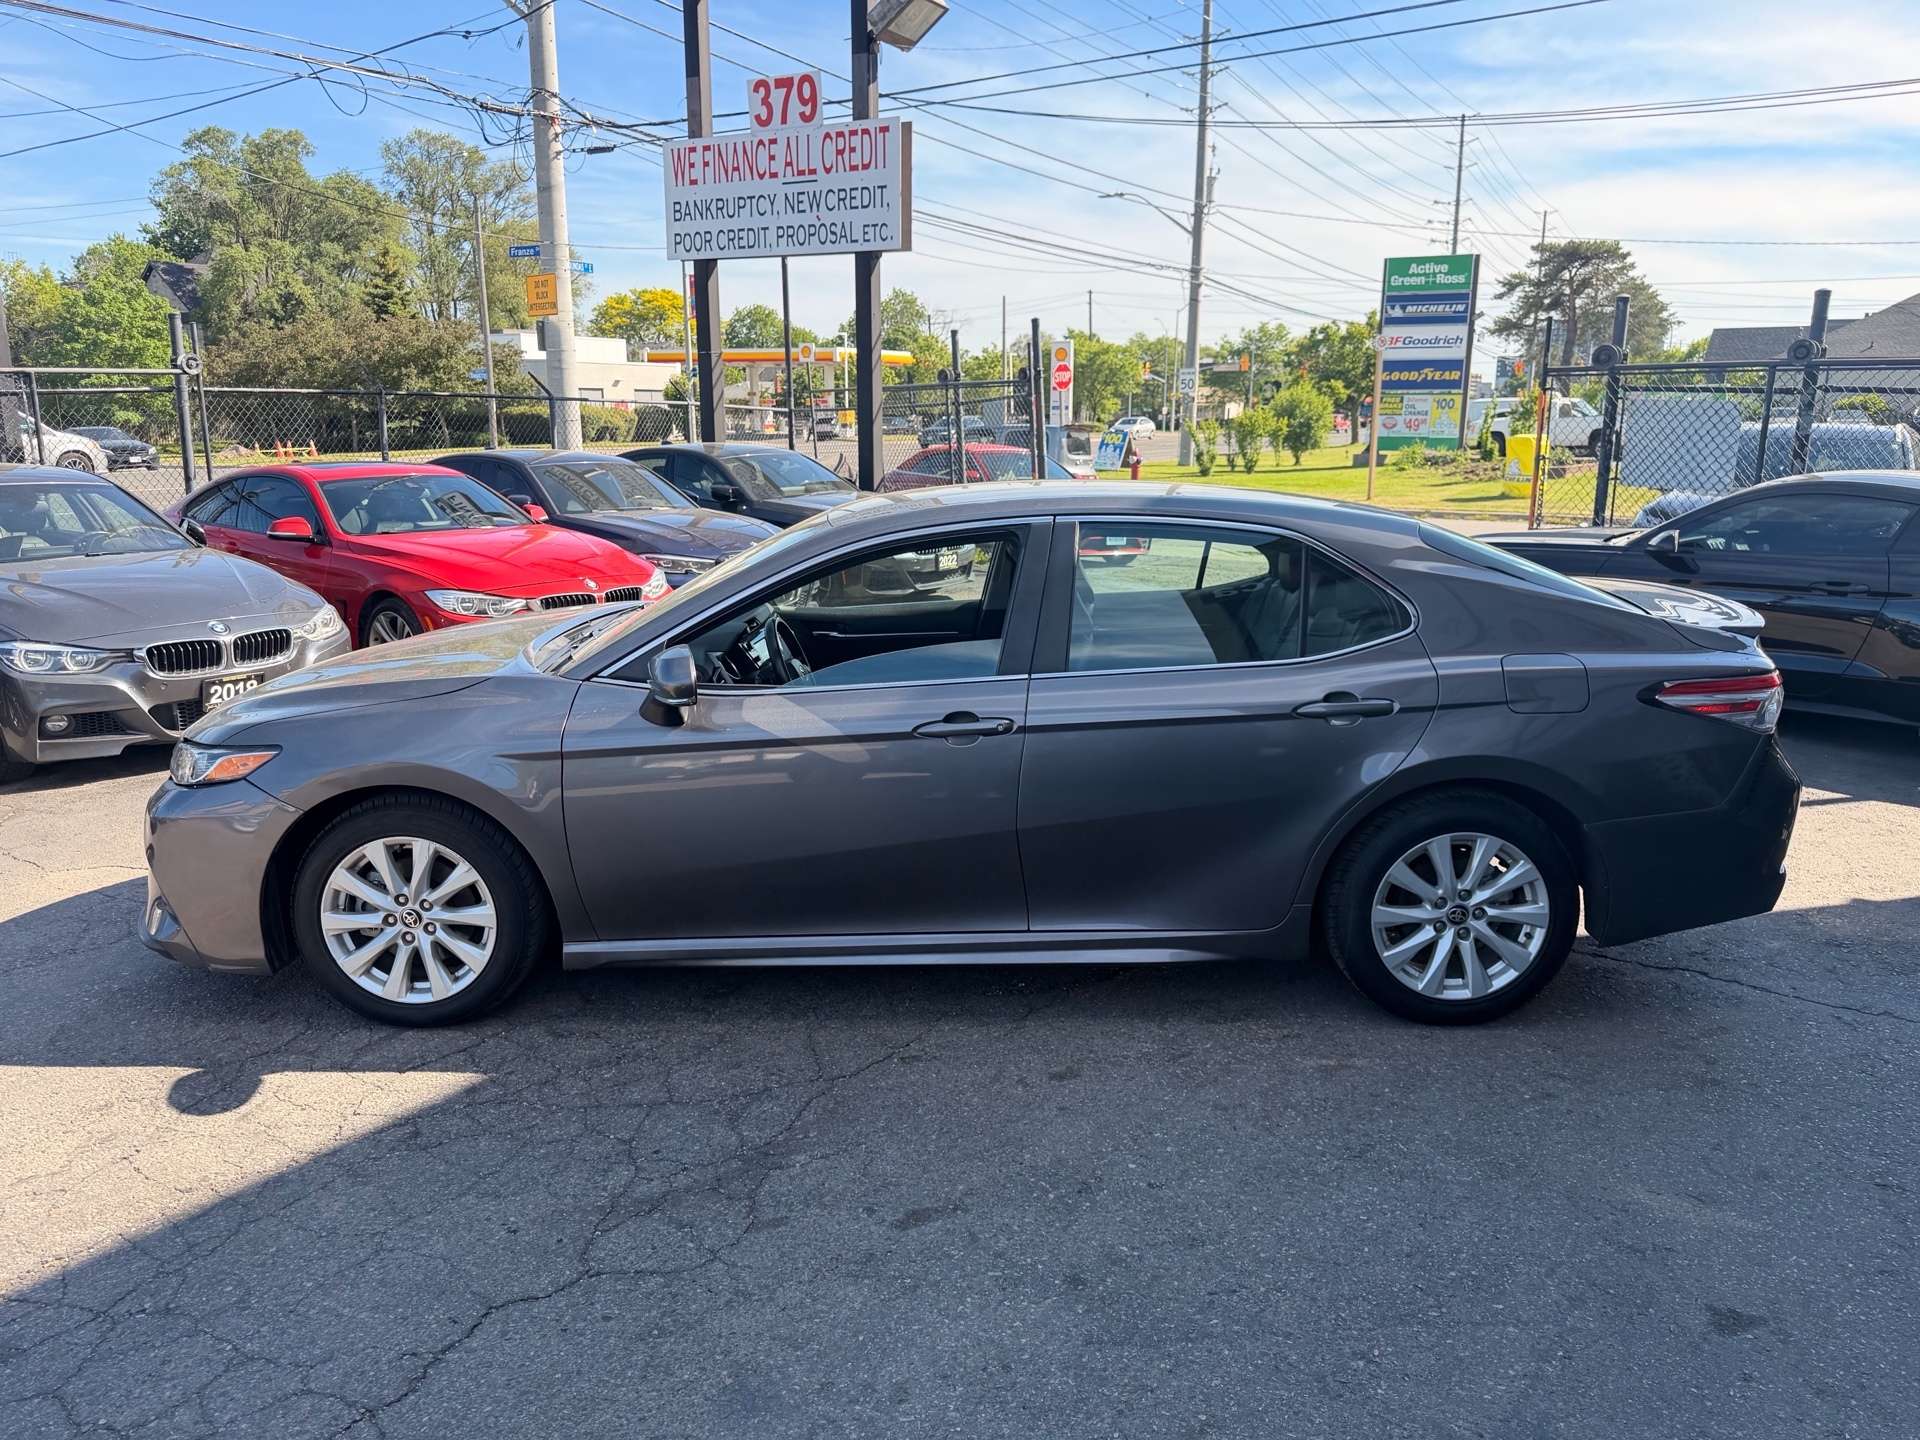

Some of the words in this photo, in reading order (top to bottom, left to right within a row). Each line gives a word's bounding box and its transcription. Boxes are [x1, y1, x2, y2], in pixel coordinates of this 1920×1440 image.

[752, 74, 818, 128] 379
[671, 145, 698, 187] WE
[702, 137, 779, 185] FINANCE
[782, 134, 817, 178] ALL
[821, 125, 890, 175] CREDIT
[673, 193, 780, 222] BANKRUPTCY,
[784, 190, 822, 215] NEW
[825, 185, 890, 212] CREDIT,
[674, 230, 713, 254] POOR
[716, 227, 773, 251] CREDIT,
[862, 222, 894, 243] ETC.
[1408, 263, 1448, 274] Active
[1405, 303, 1466, 313] MICHELIN
[1054, 371, 1071, 383] STOP
[1382, 368, 1461, 382] GOODYEAR
[1181, 378, 1194, 390] 50
[939, 554, 958, 567] 2022
